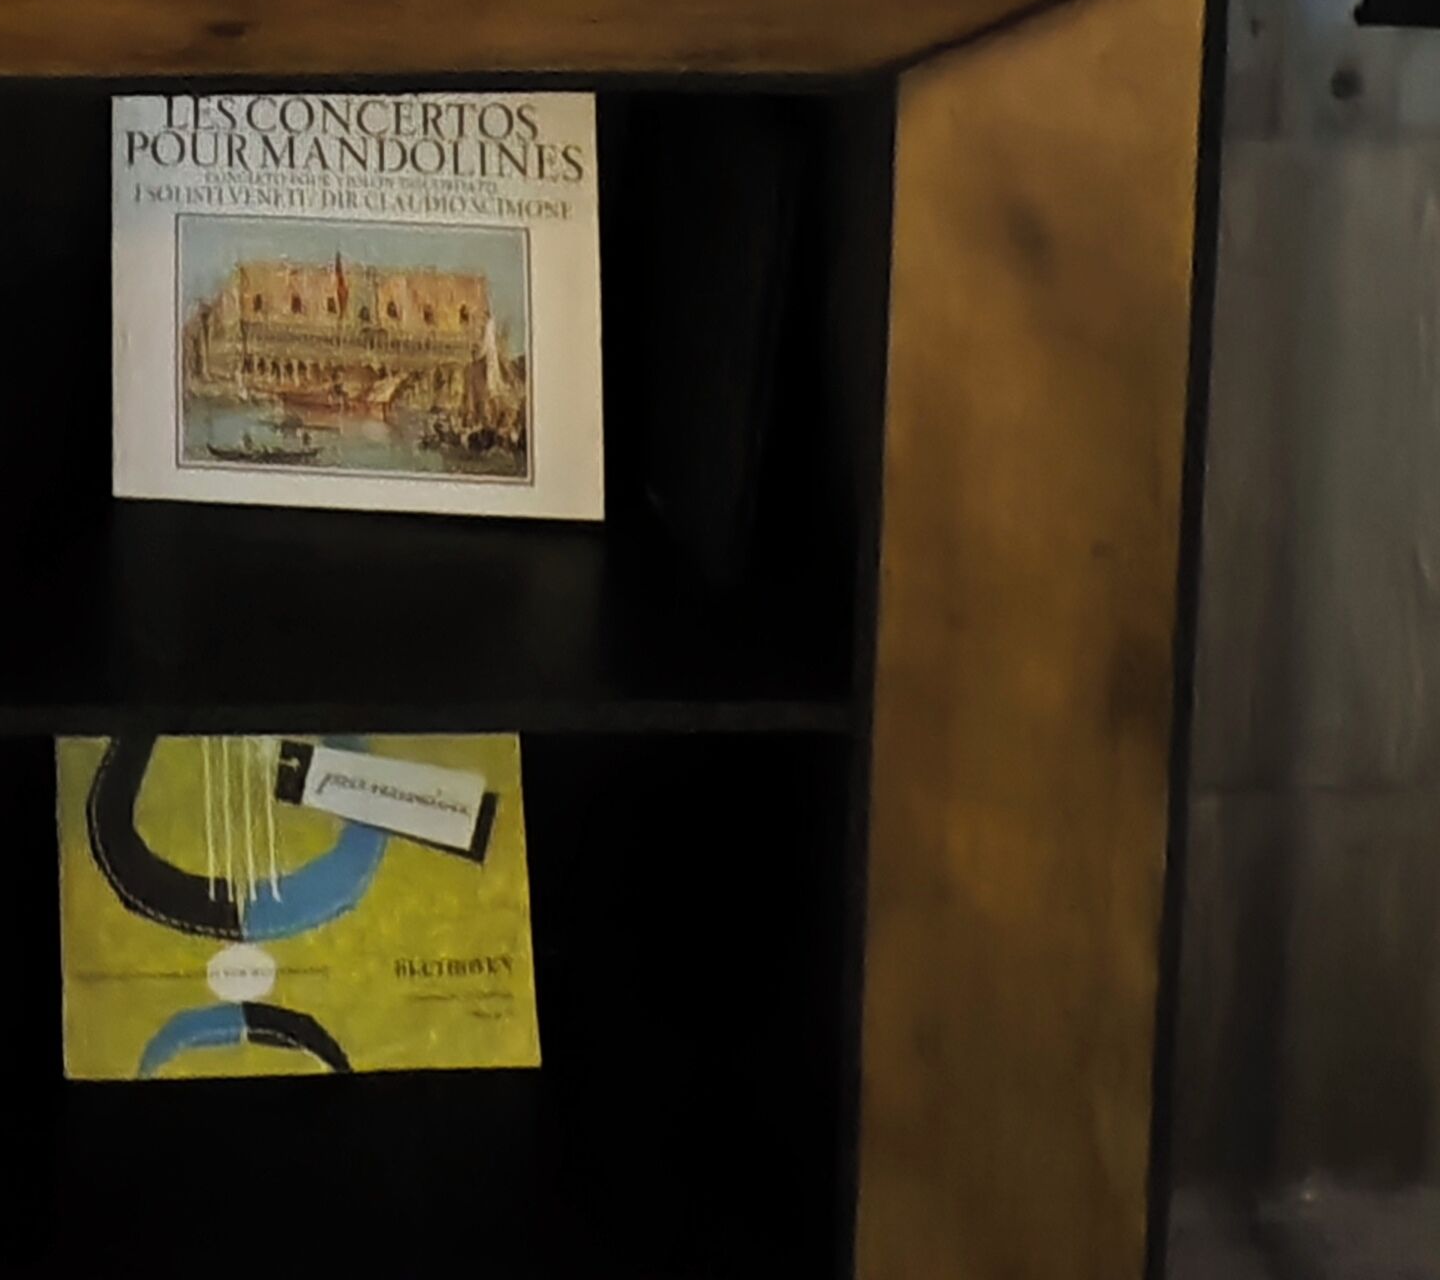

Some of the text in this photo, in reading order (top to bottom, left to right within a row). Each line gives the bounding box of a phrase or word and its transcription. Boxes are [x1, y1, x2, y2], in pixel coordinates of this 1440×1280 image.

[164, 96, 539, 142] LES CONCERTOS
[126, 130, 584, 183] POUR MANDOLINES
